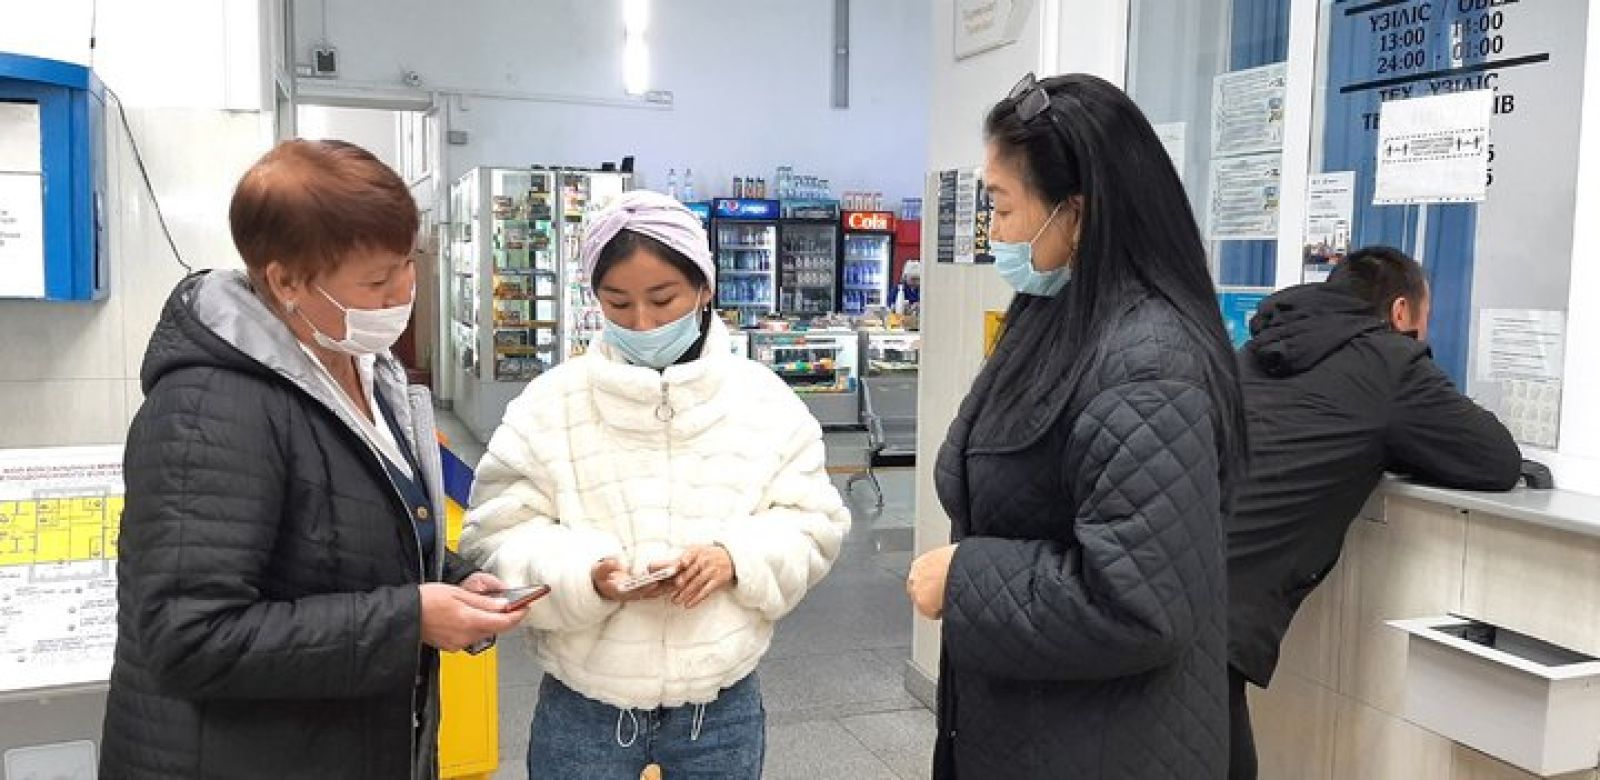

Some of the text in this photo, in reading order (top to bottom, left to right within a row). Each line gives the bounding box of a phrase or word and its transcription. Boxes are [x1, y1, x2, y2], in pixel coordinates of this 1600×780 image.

[1380, 27, 1425, 52] 13:00
[1377, 49, 1425, 74] 24:00
[1453, 35, 1503, 60] 01:00
[848, 212, 888, 230] Cola
